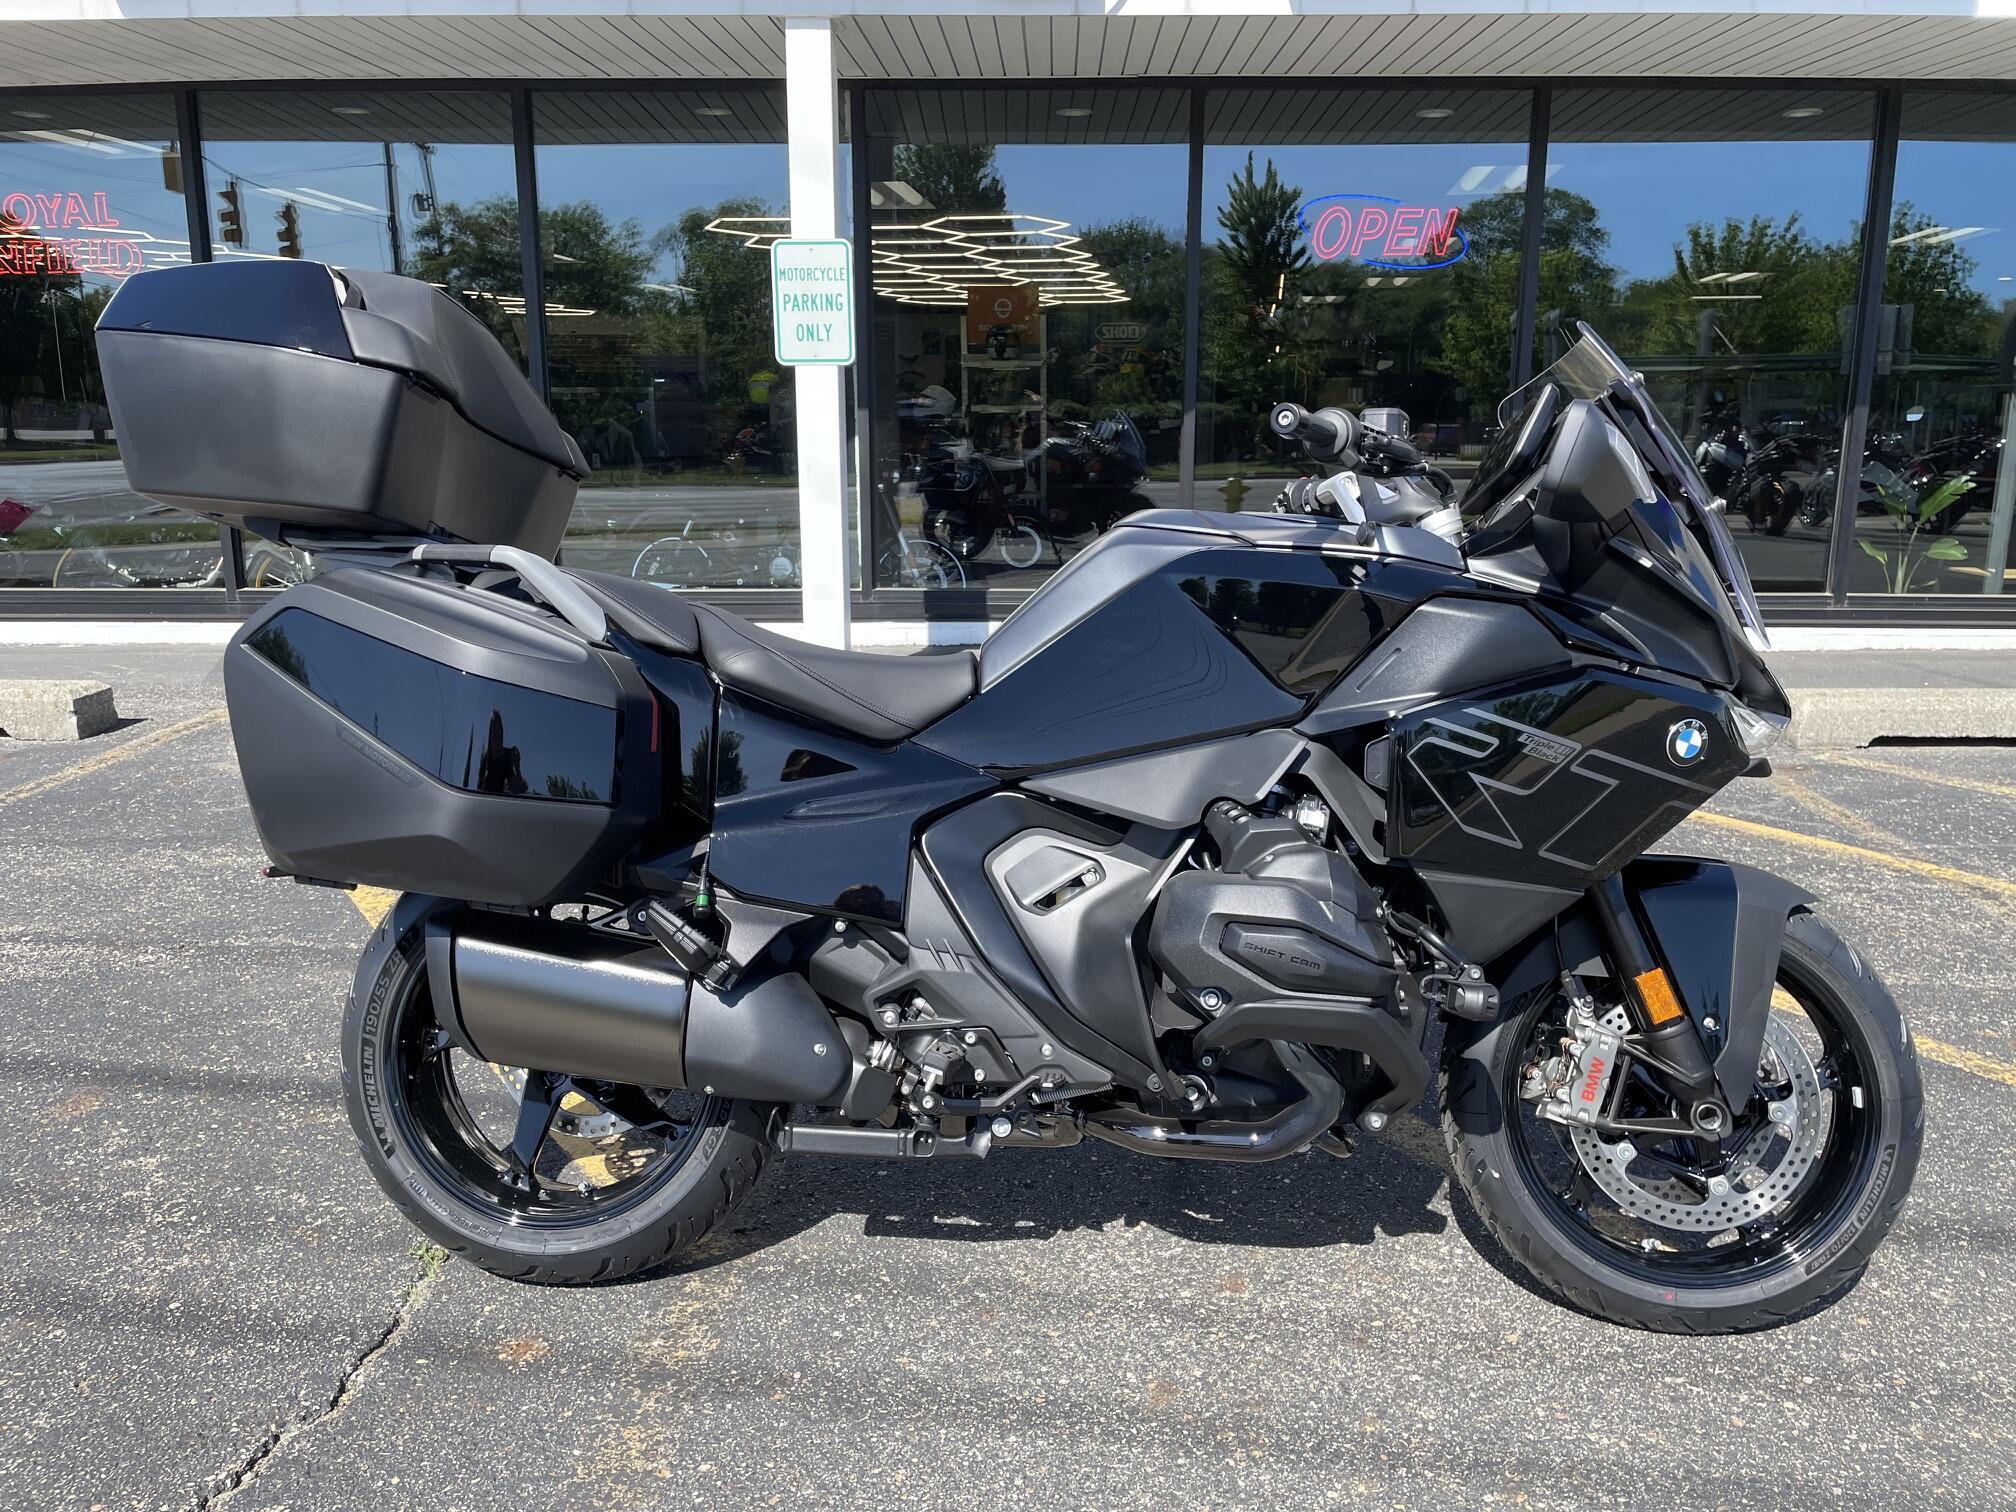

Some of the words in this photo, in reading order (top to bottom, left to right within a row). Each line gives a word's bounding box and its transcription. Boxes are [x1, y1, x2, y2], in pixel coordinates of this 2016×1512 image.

[0, 192, 119, 233] OYAL
[1313, 206, 1459, 260] OPEN
[0, 239, 142, 280] NFIELD
[779, 267, 846, 282] MOTORCYCLE
[783, 293, 844, 312] PARKING
[796, 323, 832, 342] ONLY
[1101, 326, 1140, 339] SHOEI
[1523, 735, 1555, 751] Triple
[1527, 746, 1560, 763] Black
[1243, 942, 1286, 959] SHIFT
[1290, 956, 1321, 971] CAM
[365, 975, 391, 1034] 190/55
[363, 1046, 386, 1128] MICHELIN
[1580, 1056, 1605, 1103] BMW
[1859, 1163, 1890, 1219] MICHELIN
